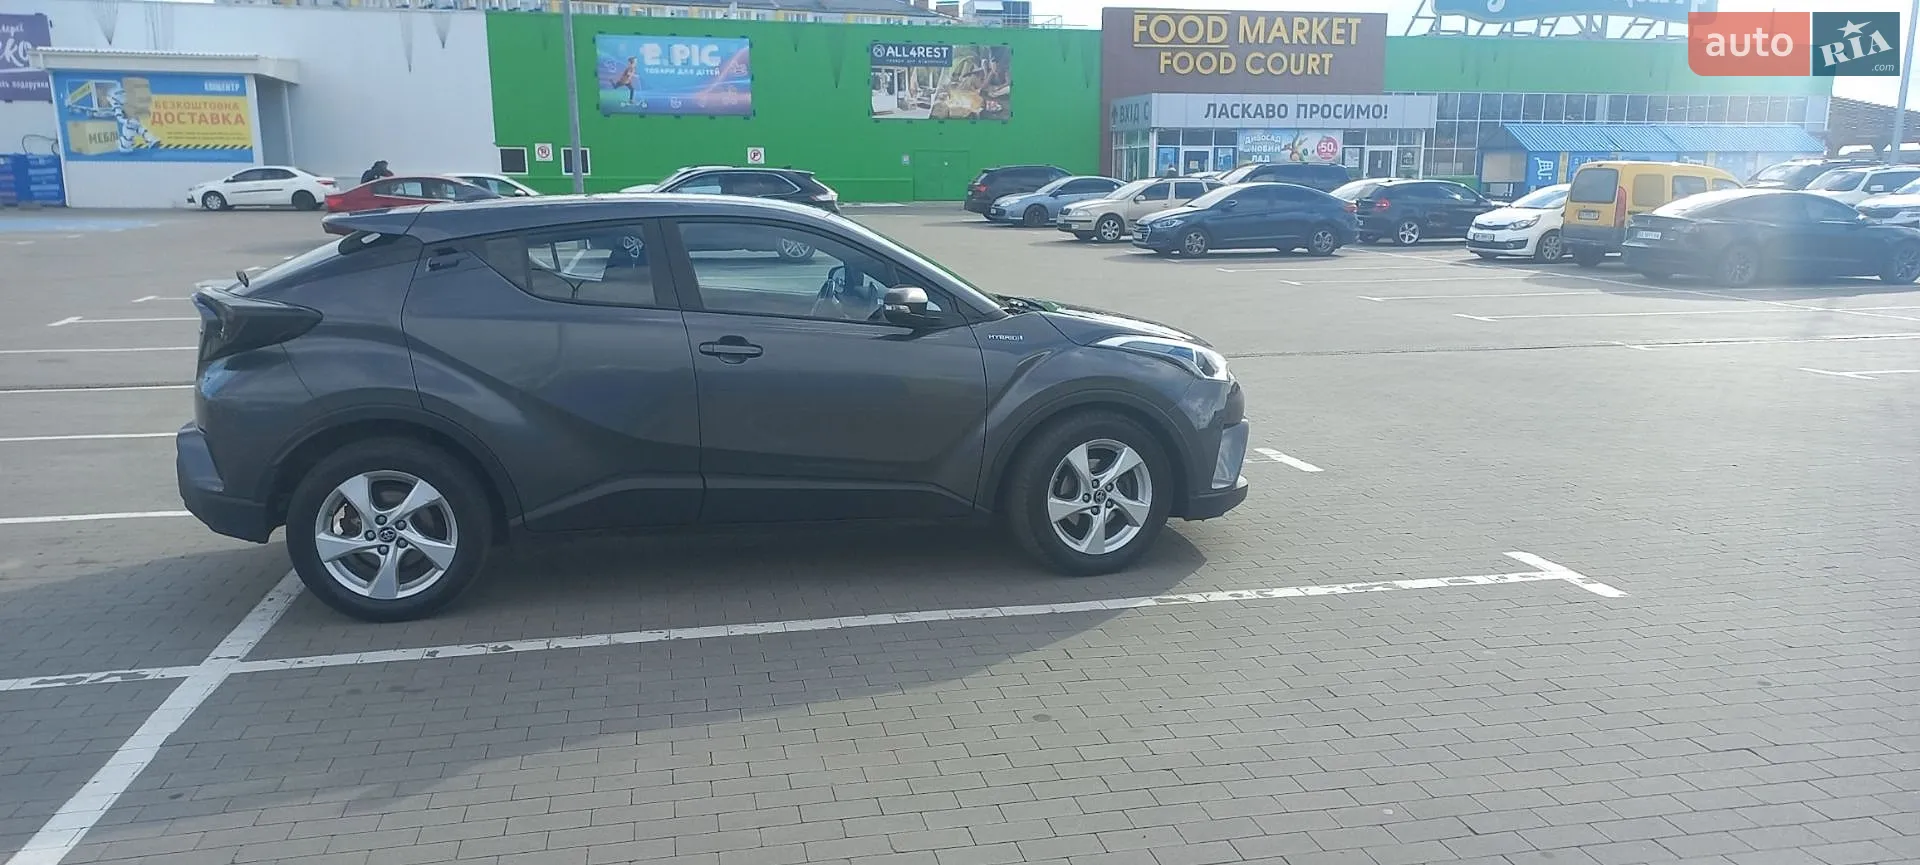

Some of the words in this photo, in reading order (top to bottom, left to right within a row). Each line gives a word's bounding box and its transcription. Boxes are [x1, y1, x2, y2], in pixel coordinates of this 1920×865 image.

[1133, 14, 1229, 45] FOOD
[1237, 16, 1363, 46] MARKET
[885, 45, 950, 60] ALL4REST
[1157, 51, 1237, 75] FOOD
[1243, 52, 1335, 77] COURT
[154, 100, 240, 111] БЕЗКОШТОВНА
[1204, 103, 1289, 120] ЛАСКАВО
[1296, 103, 1389, 120] ПРОСИМО!
[151, 111, 246, 126] ДОСТАВКА
